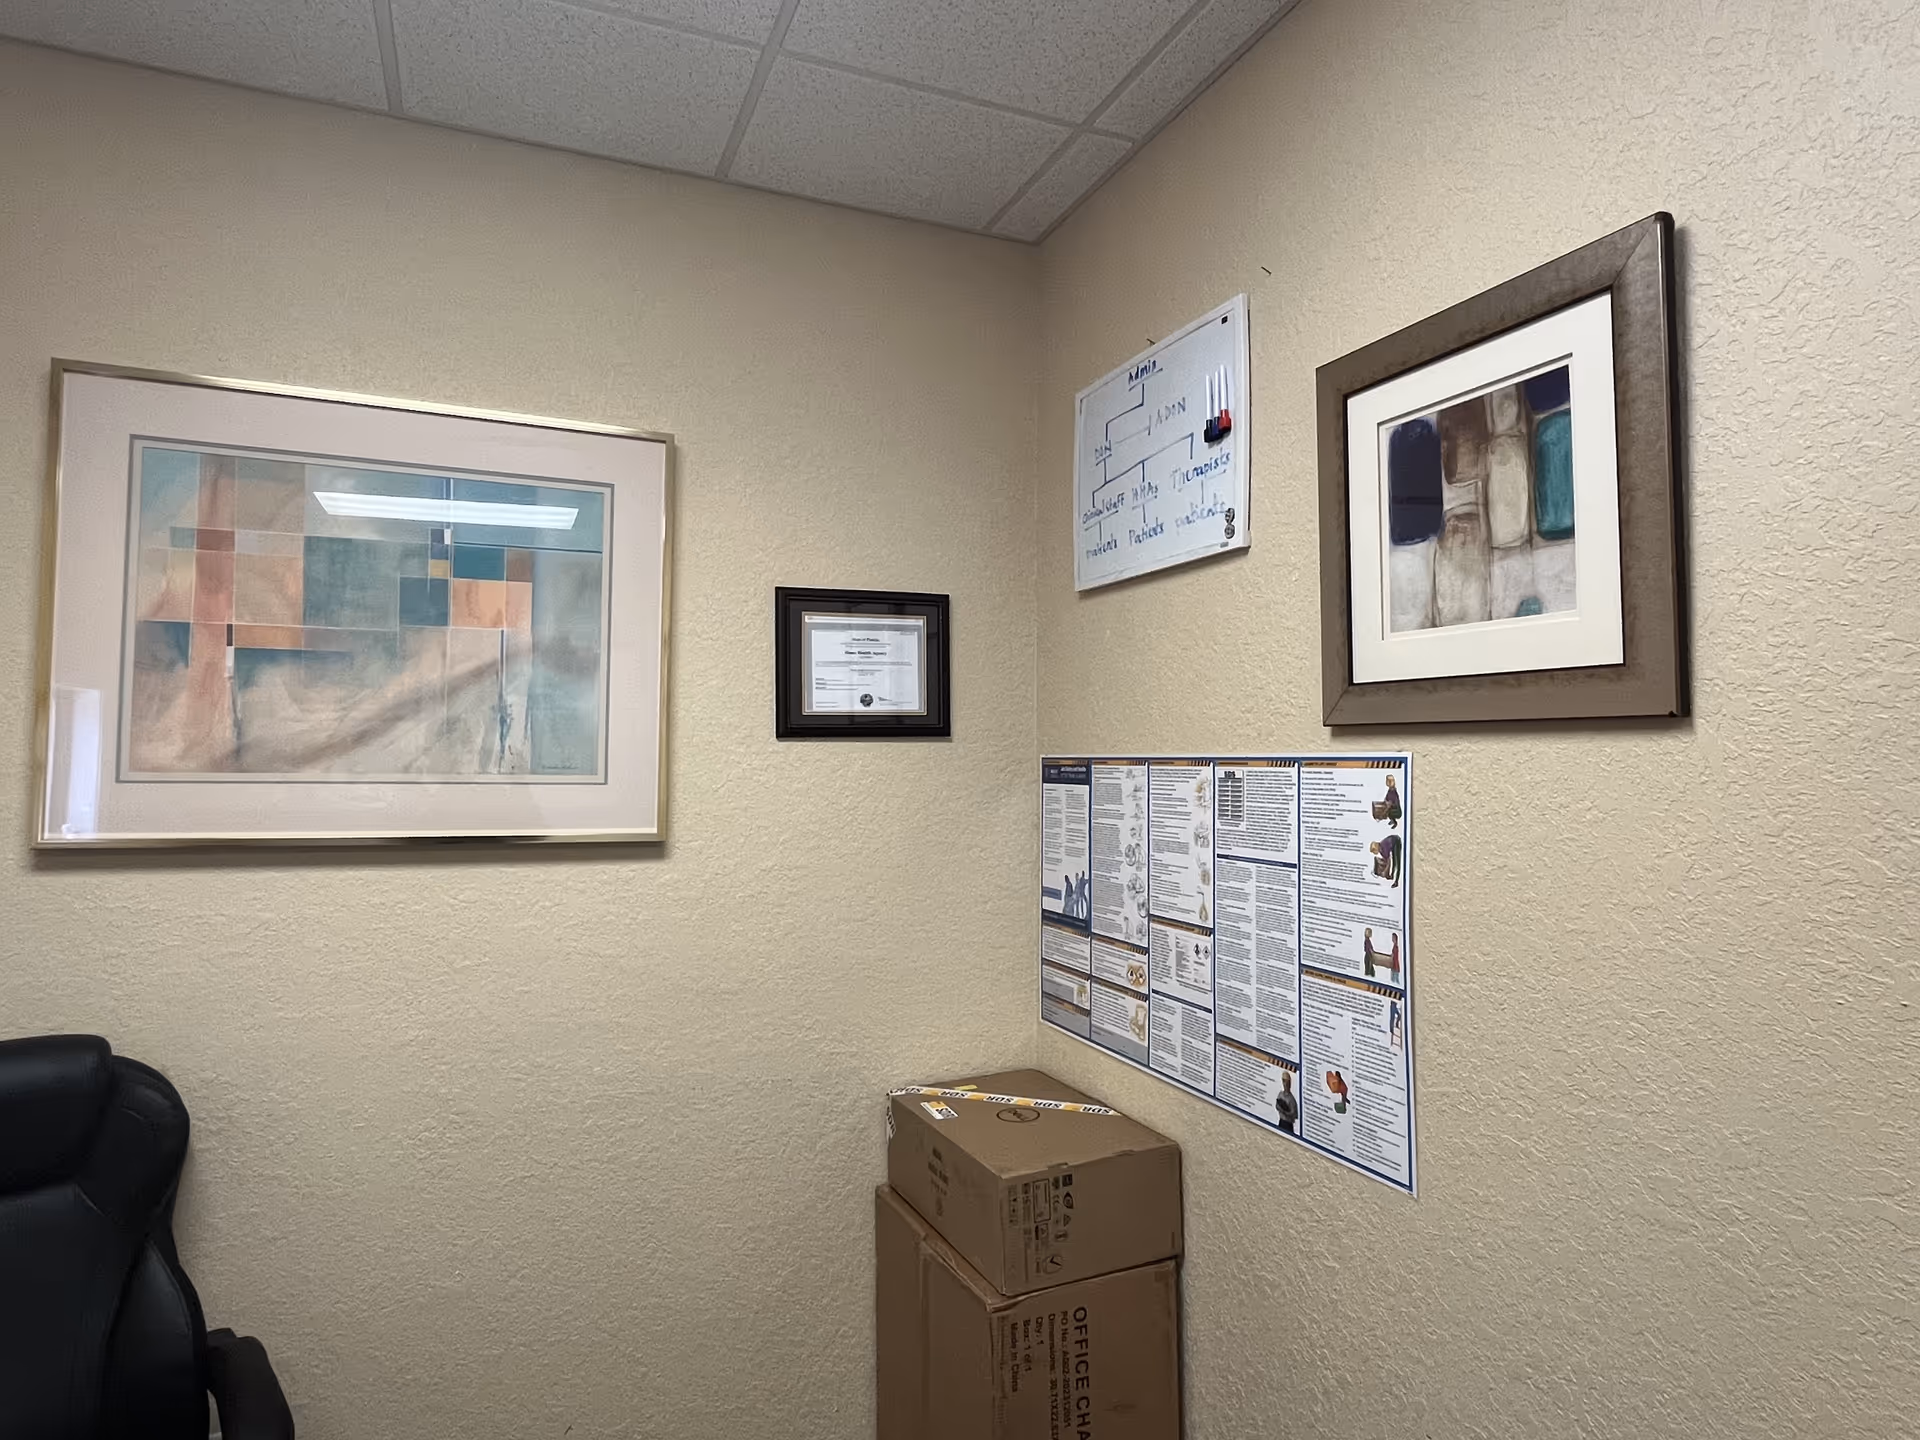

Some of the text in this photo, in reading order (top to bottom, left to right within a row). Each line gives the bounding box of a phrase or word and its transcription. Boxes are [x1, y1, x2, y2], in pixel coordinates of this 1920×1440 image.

[940, 1090, 968, 1098] SDR
[986, 1095, 1015, 1104] SDR
[1033, 1100, 1062, 1109] SDR
[1082, 1106, 1112, 1115] SDR
[1073, 1306, 1090, 1391] OFFICE
